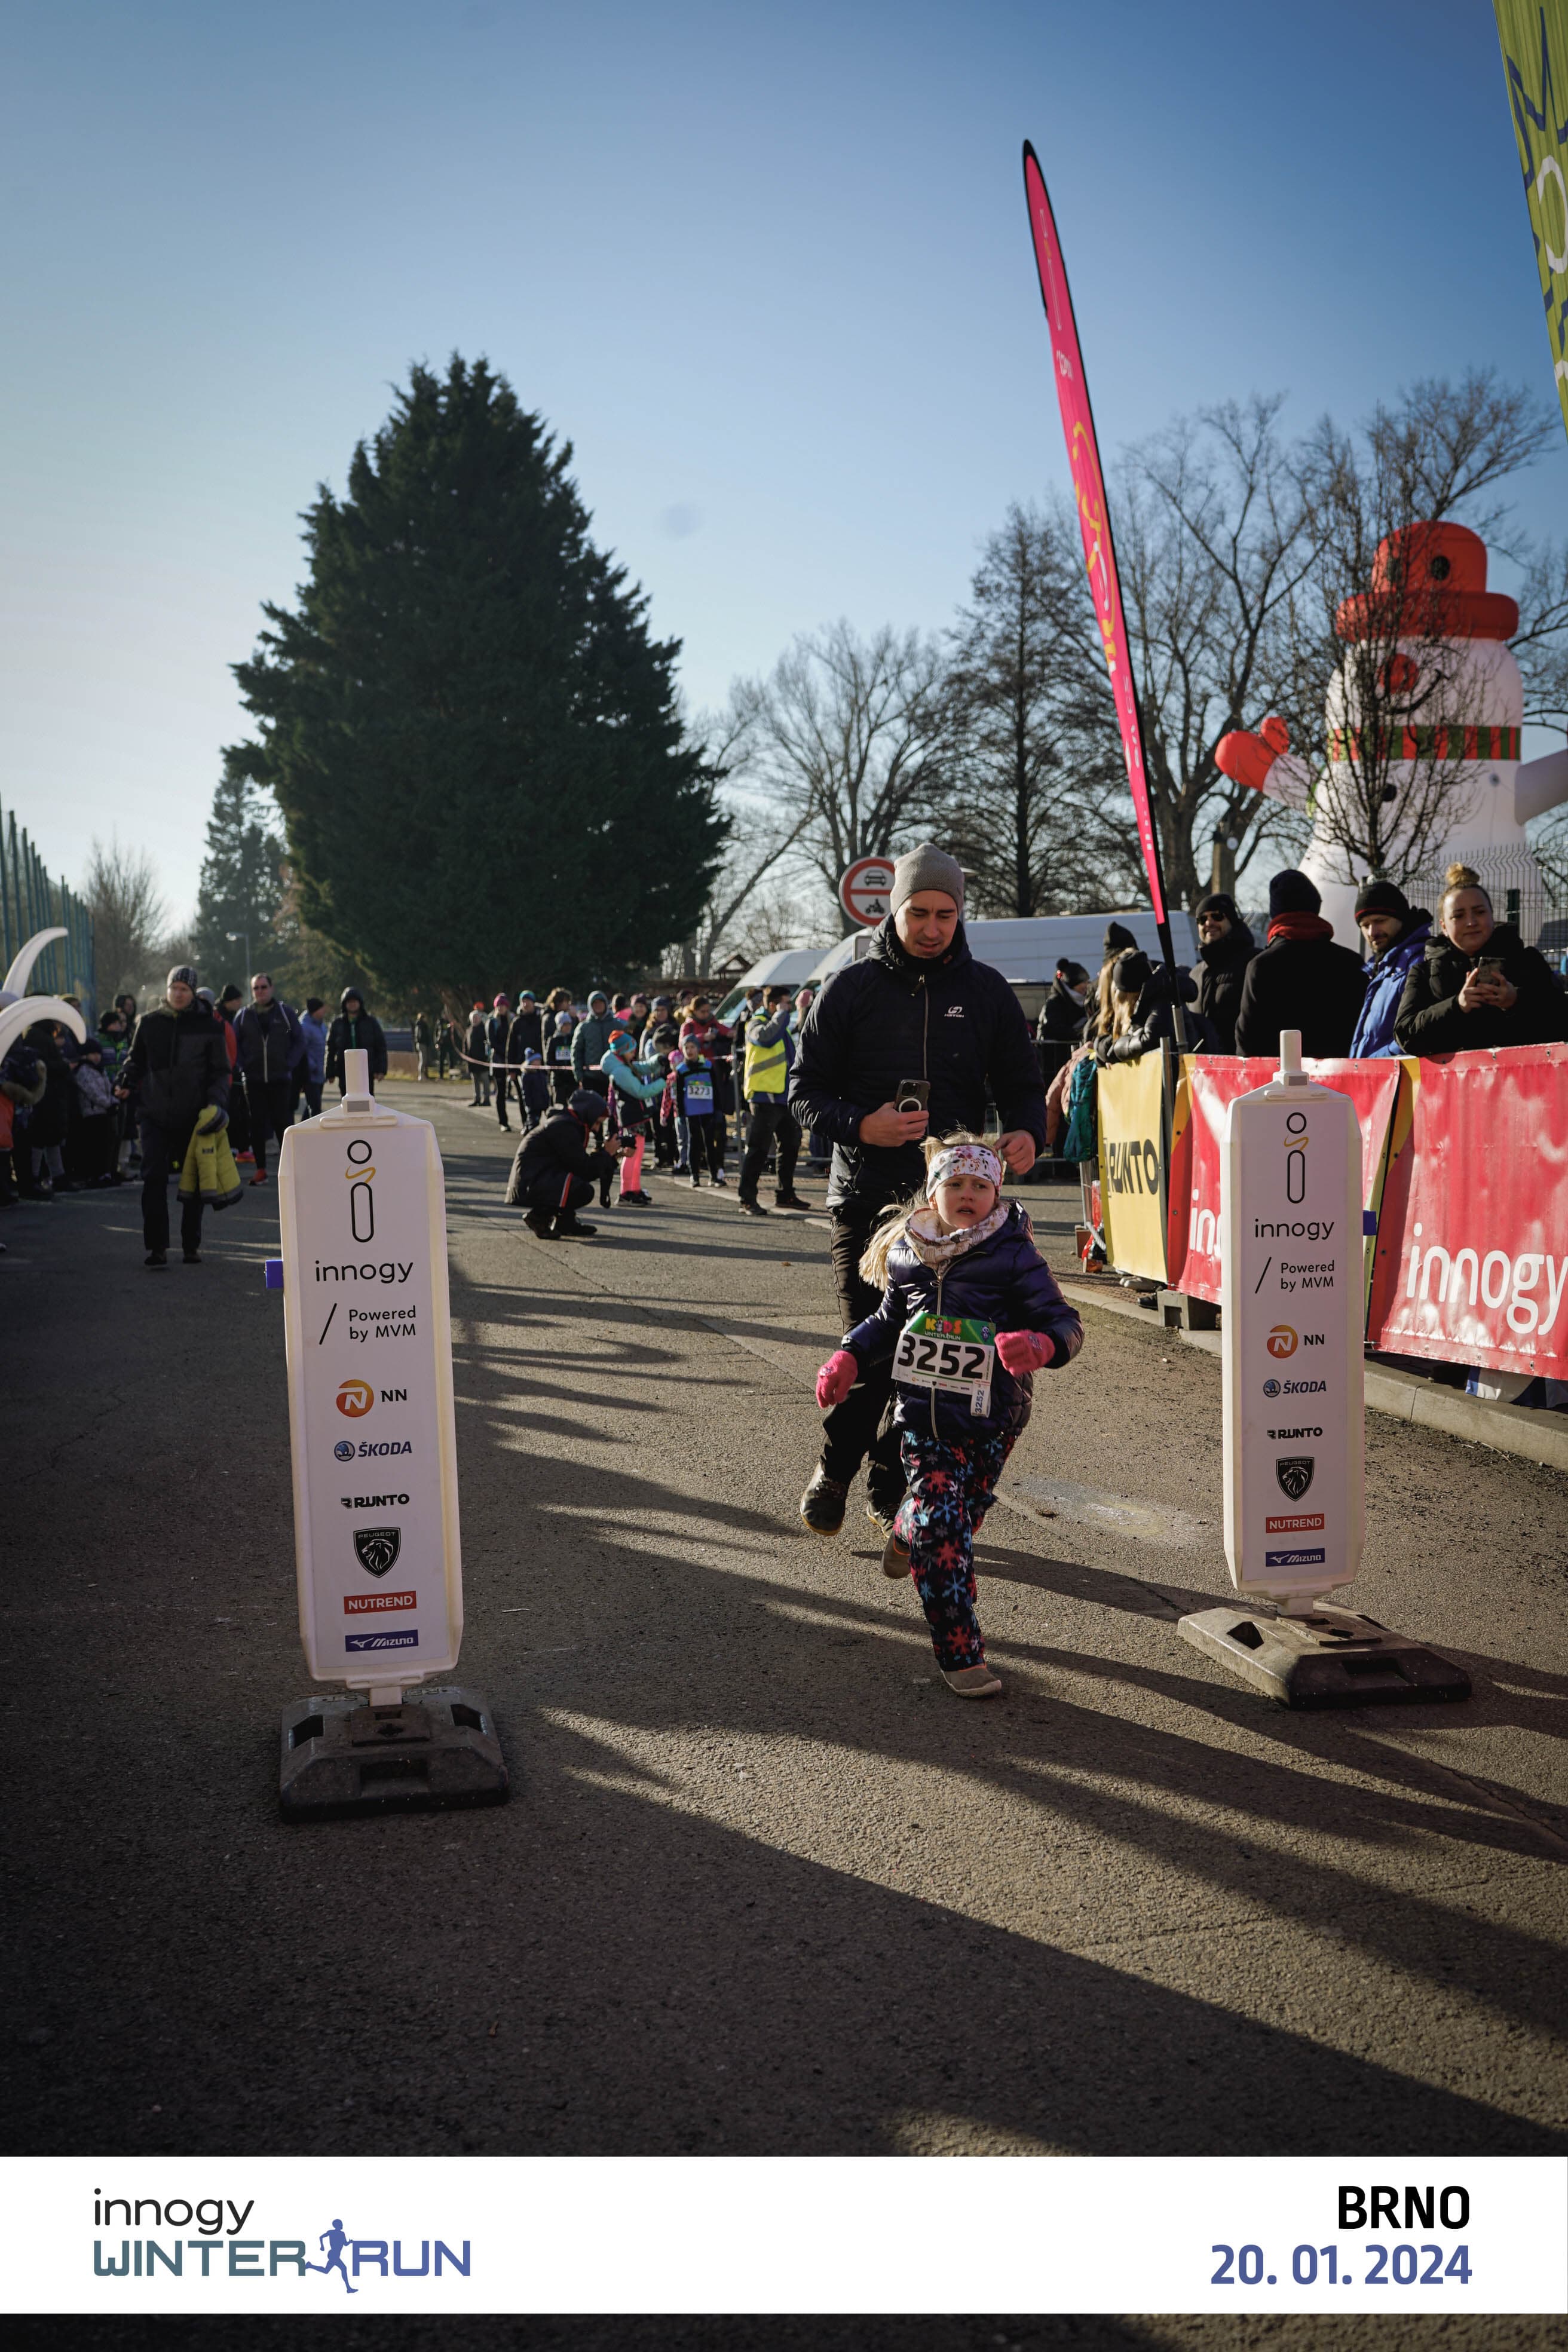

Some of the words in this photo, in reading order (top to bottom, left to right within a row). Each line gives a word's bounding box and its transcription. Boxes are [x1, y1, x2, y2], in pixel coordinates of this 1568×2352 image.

[1109, 1138, 1159, 1195] RUNTO
[1255, 1218, 1334, 1241] innogy
[315, 1260, 414, 1284] innogy
[1281, 1260, 1334, 1274] Powered
[1281, 1278, 1296, 1293] by
[1301, 1276, 1334, 1288] MVM
[1406, 1222, 1568, 1336] innogy
[349, 1304, 416, 1322] Powered
[350, 1326, 369, 1343] by
[375, 1323, 416, 1338] MVM
[1303, 1334, 1325, 1346] NN
[897, 1333, 985, 1379] 3252
[1282, 1380, 1327, 1394] ŠKODA
[380, 1389, 408, 1402] NN
[975, 1389, 985, 1414] 3252
[1278, 1427, 1323, 1440] RUNTO
[358, 1441, 412, 1457] ŠKODA
[354, 1493, 410, 1508] RUNTO
[1269, 1517, 1322, 1530] NUTREND
[348, 1595, 414, 1610] NUTREND
